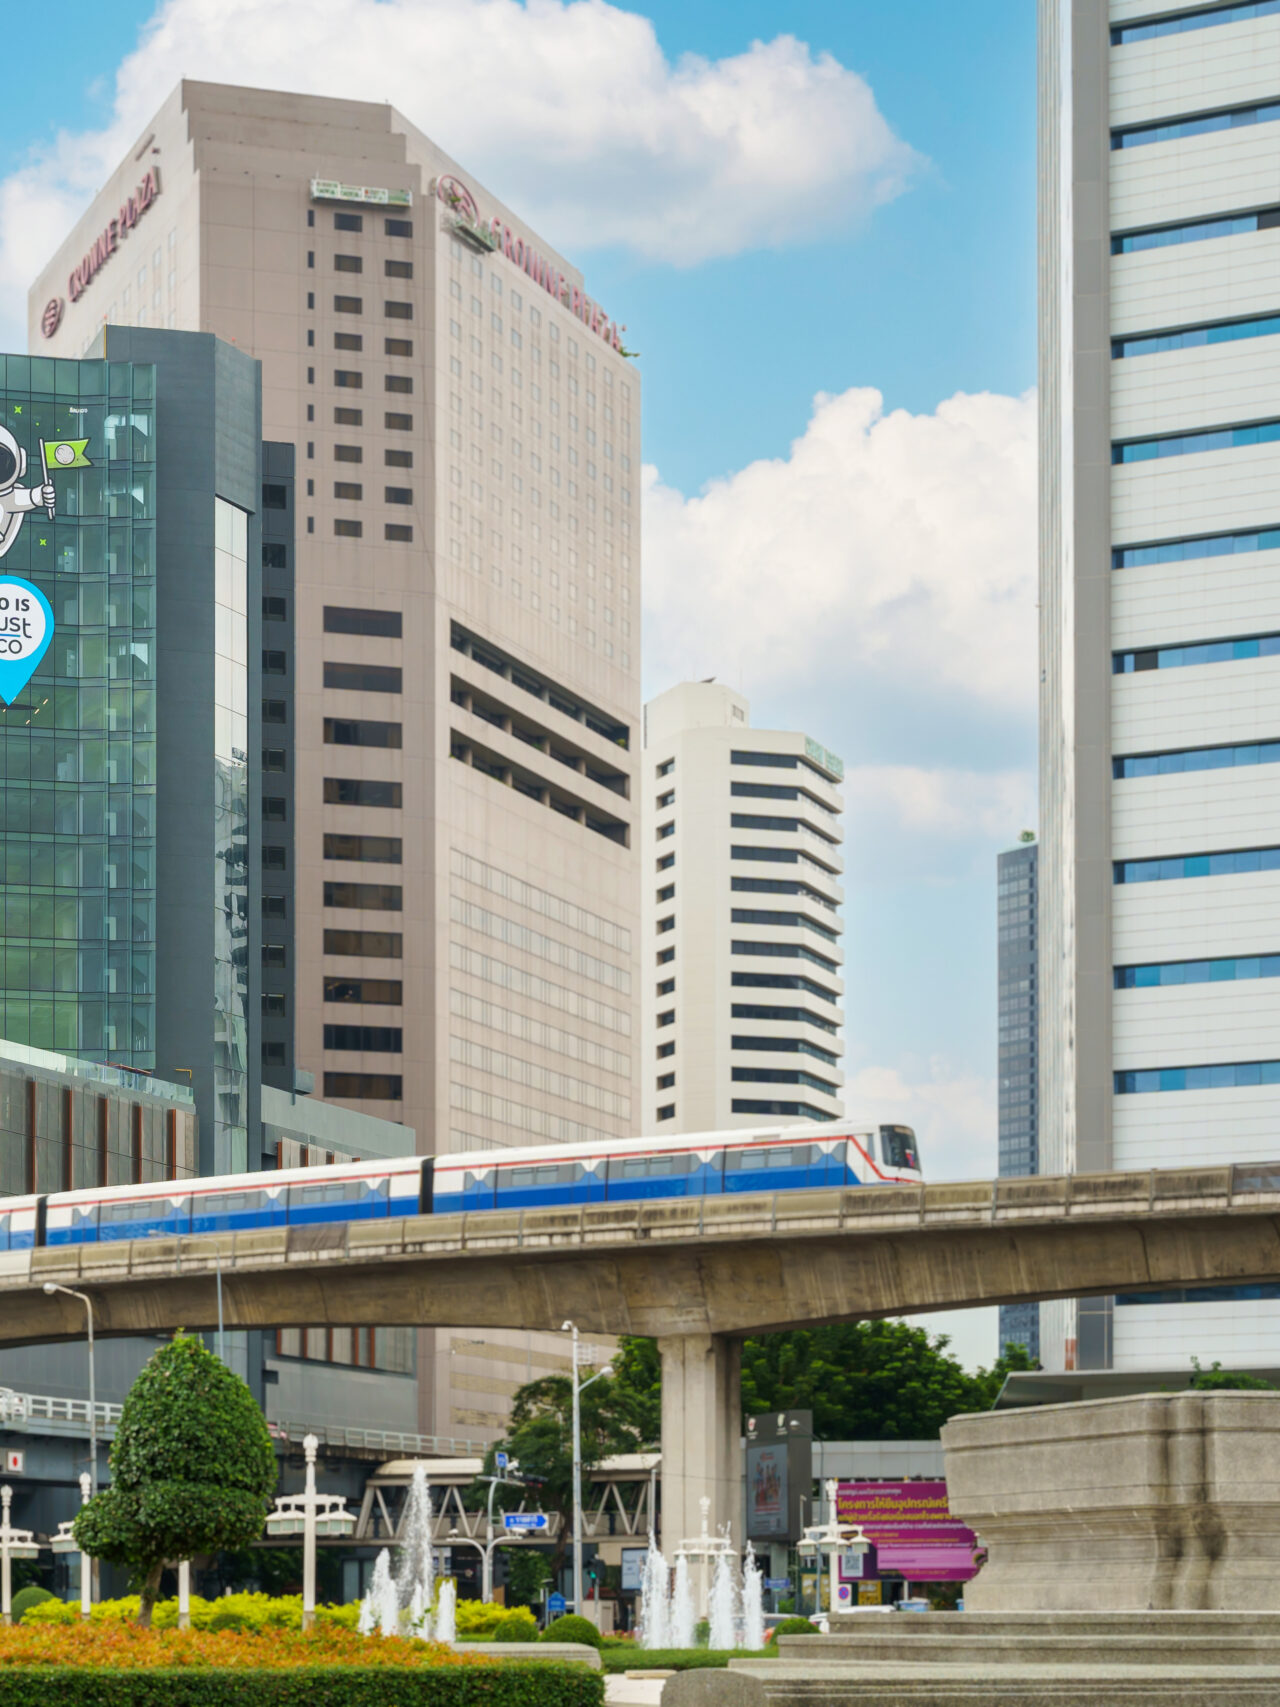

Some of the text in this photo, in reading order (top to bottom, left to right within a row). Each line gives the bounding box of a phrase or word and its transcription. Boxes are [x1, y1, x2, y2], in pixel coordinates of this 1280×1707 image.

[68, 165, 161, 302] CROWNE PLAZA
[15, 598, 30, 612] IS
